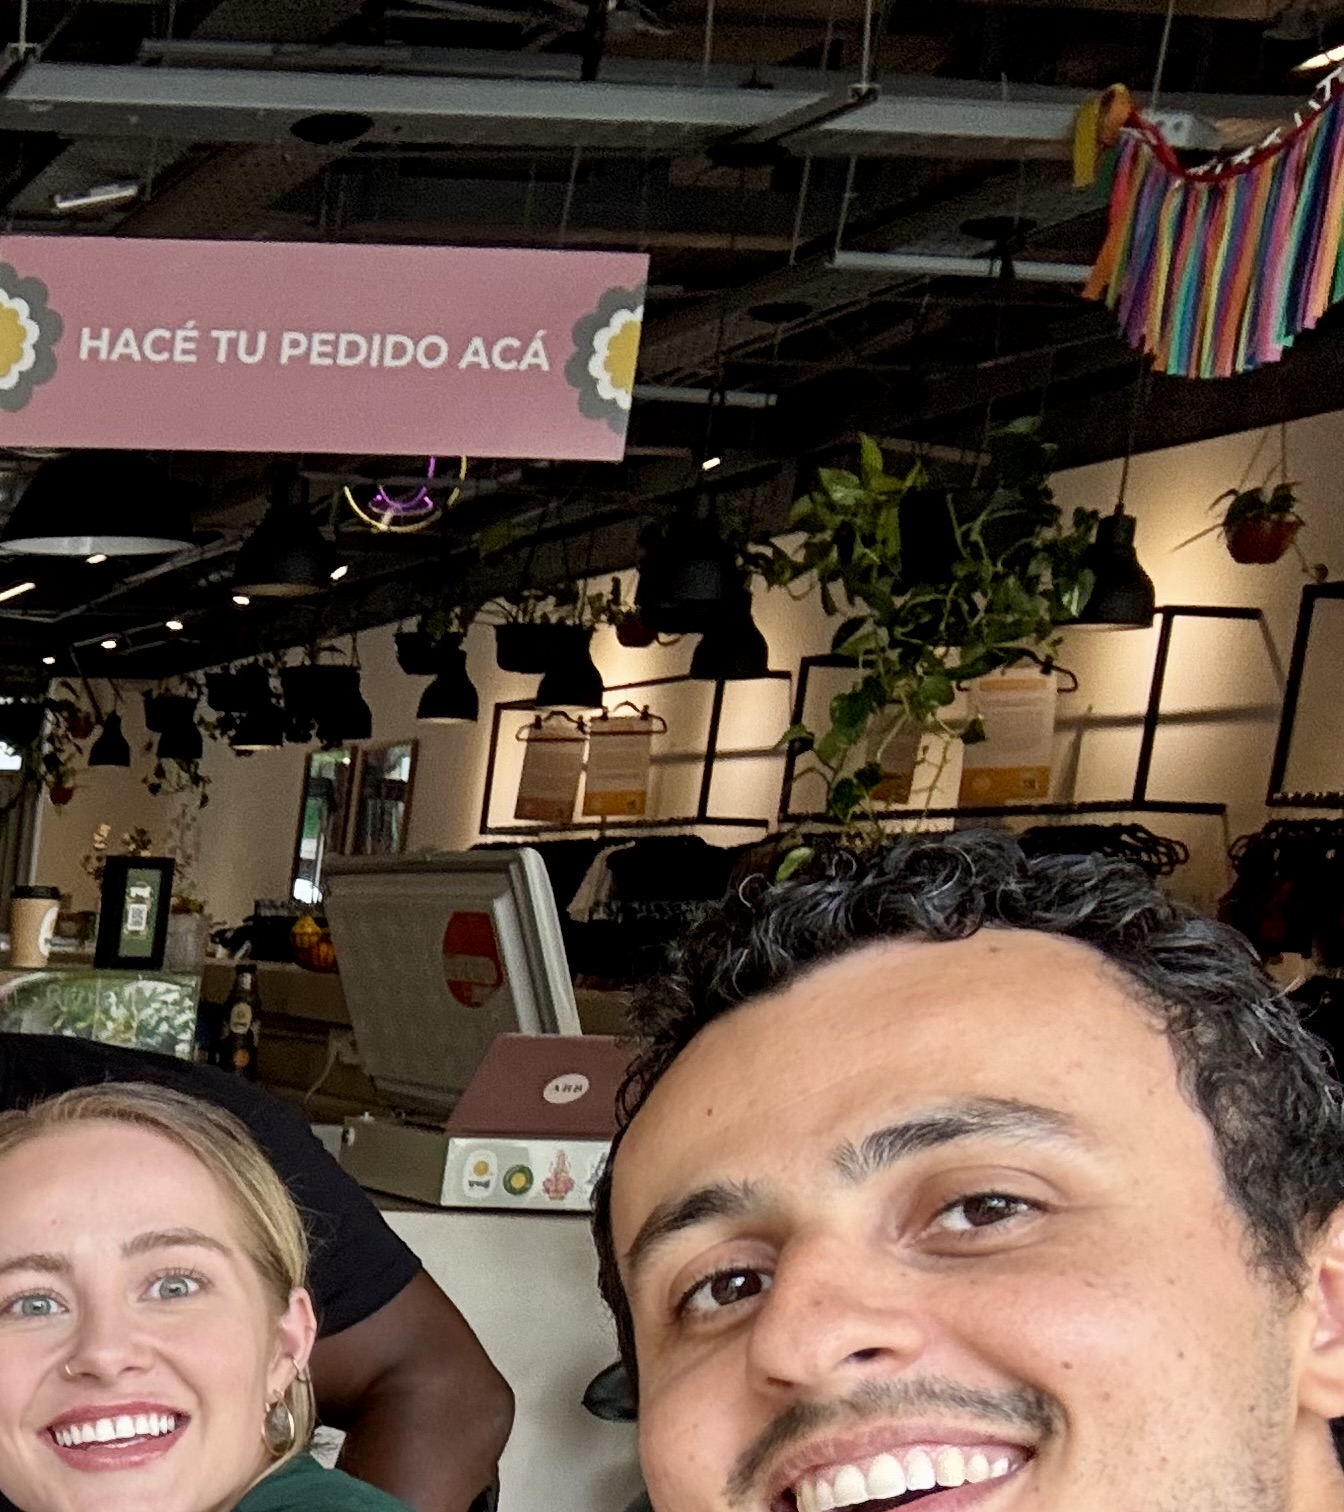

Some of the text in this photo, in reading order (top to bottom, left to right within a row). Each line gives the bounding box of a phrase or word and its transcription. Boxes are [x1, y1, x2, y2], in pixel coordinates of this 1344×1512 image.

[79, 321, 550, 373] HACÉ TU PEDIDO ACÁ
